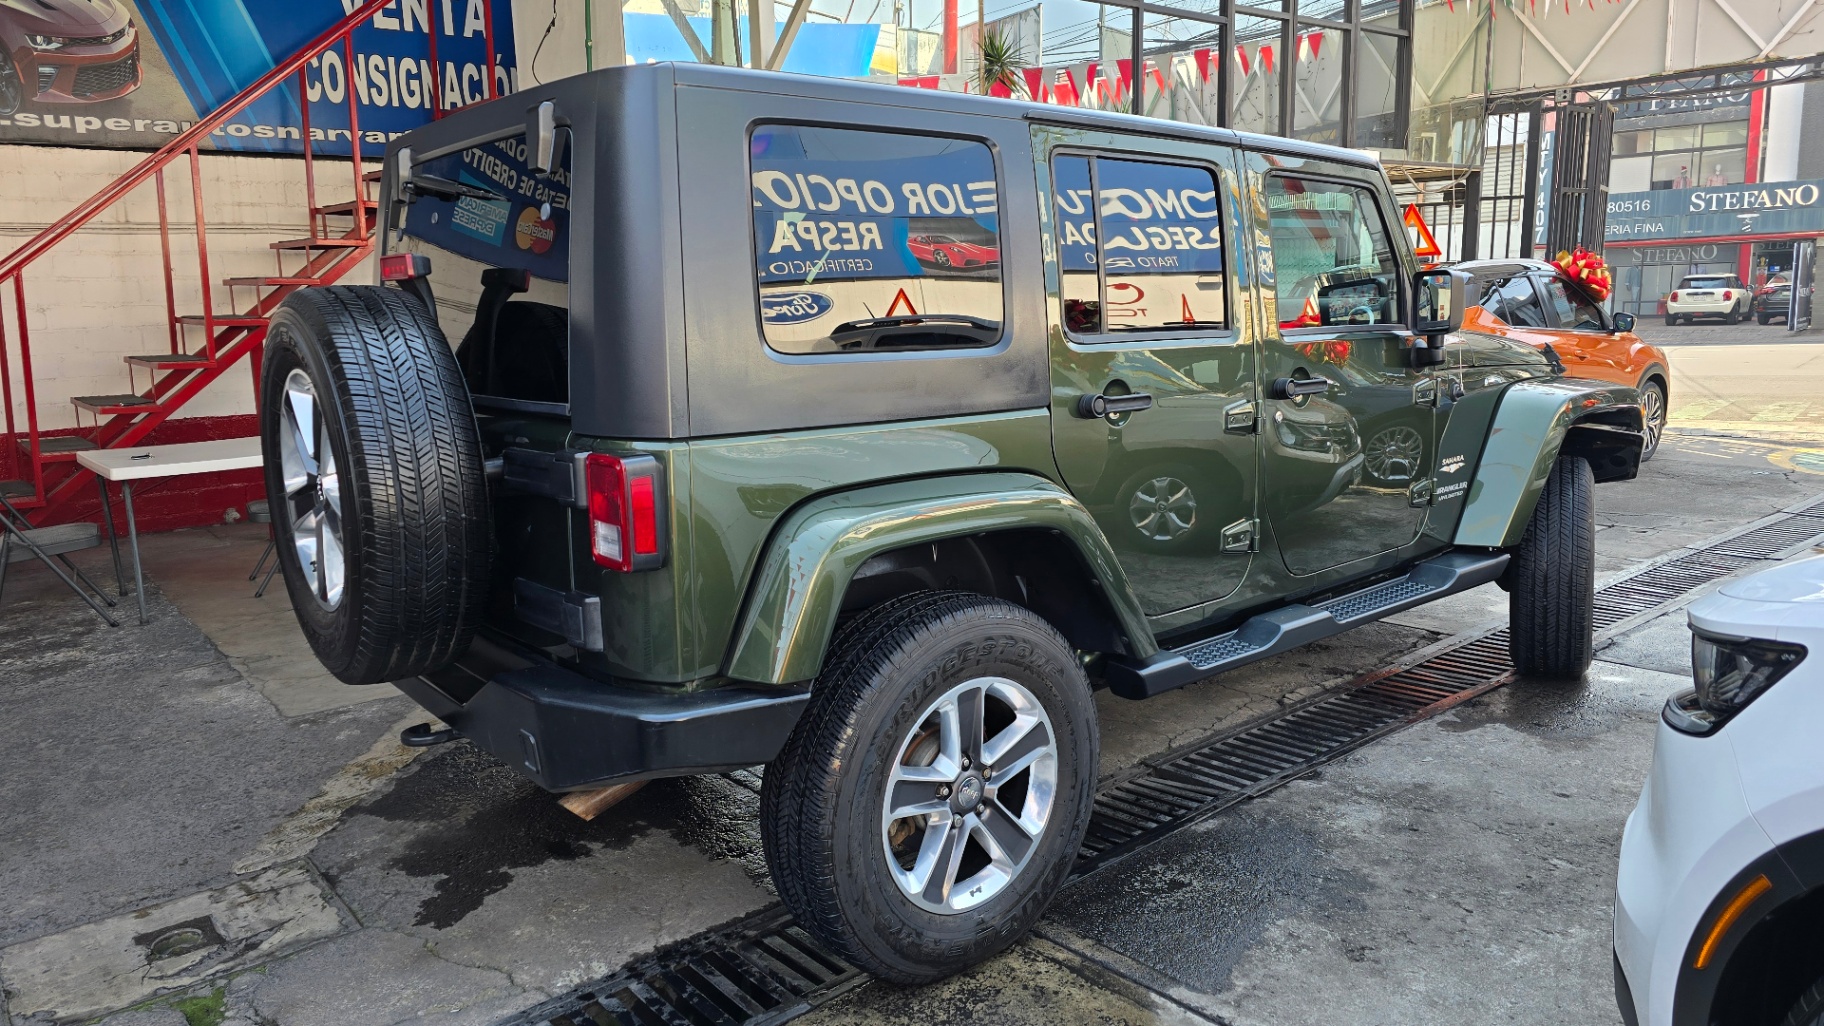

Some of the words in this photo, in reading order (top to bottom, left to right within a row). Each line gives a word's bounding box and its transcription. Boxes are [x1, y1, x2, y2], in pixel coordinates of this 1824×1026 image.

[1606, 199, 1651, 214] 80516
[1689, 184, 1820, 213] STEFANO
[1535, 192, 1546, 244] 407
[1634, 222, 1665, 234] FINA
[1632, 244, 1718, 262] STEFANO
[1442, 455, 1465, 465] SAHARA
